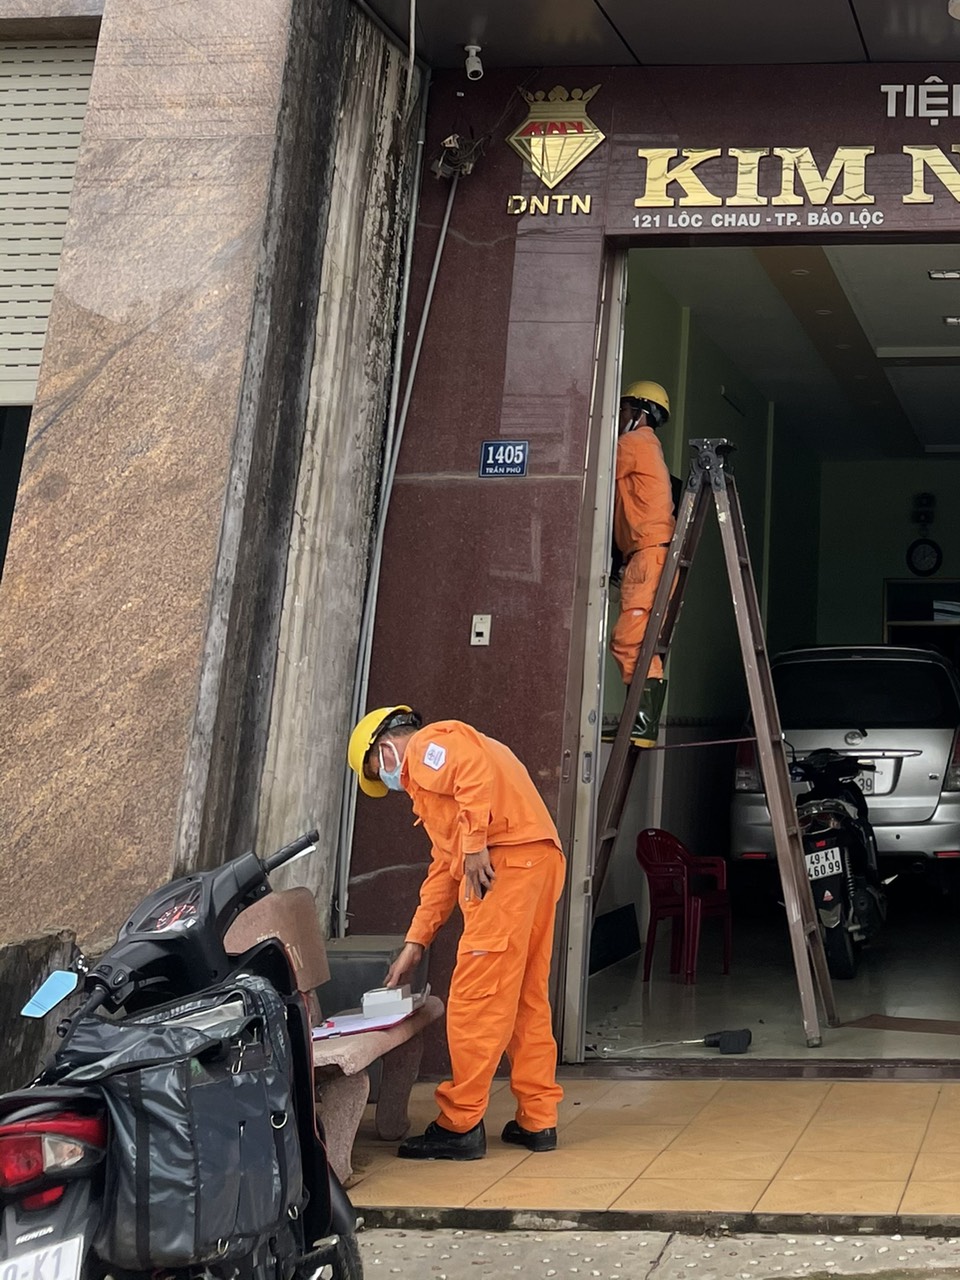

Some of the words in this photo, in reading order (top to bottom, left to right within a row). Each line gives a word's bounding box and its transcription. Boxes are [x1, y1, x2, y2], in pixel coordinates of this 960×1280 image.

[634, 145, 875, 208] KIM
[507, 194, 592, 215] DNTN
[632, 214, 661, 228] 121
[775, 212, 801, 226] TP.
[808, 207, 843, 226] BẢO
[849, 208, 884, 229] LỘC
[486, 445, 524, 464] 1405
[810, 850, 835, 865] 49-K1
